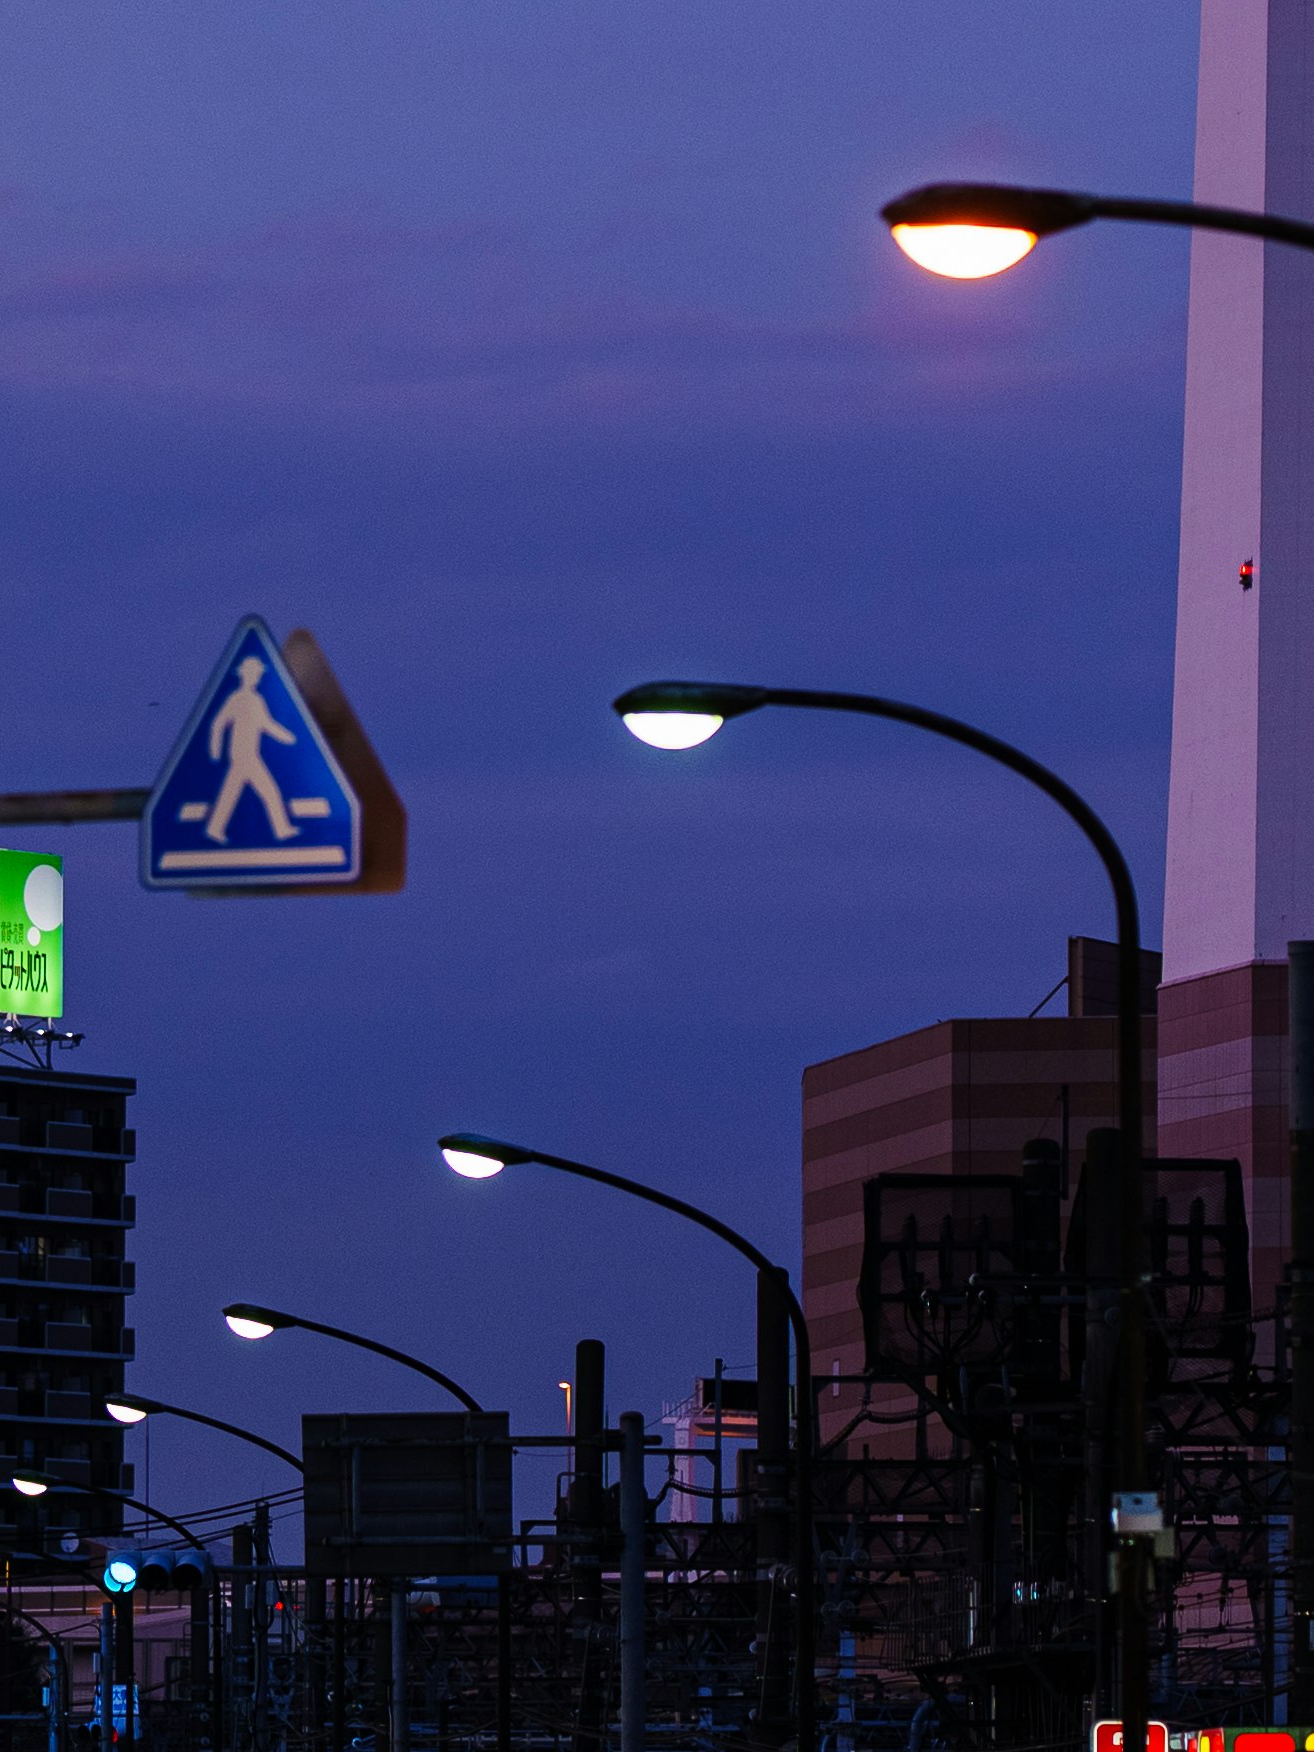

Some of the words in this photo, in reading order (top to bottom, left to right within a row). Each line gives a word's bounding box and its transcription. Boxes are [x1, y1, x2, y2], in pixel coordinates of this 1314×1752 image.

[0, 948, 49, 993] ピタットハウス
